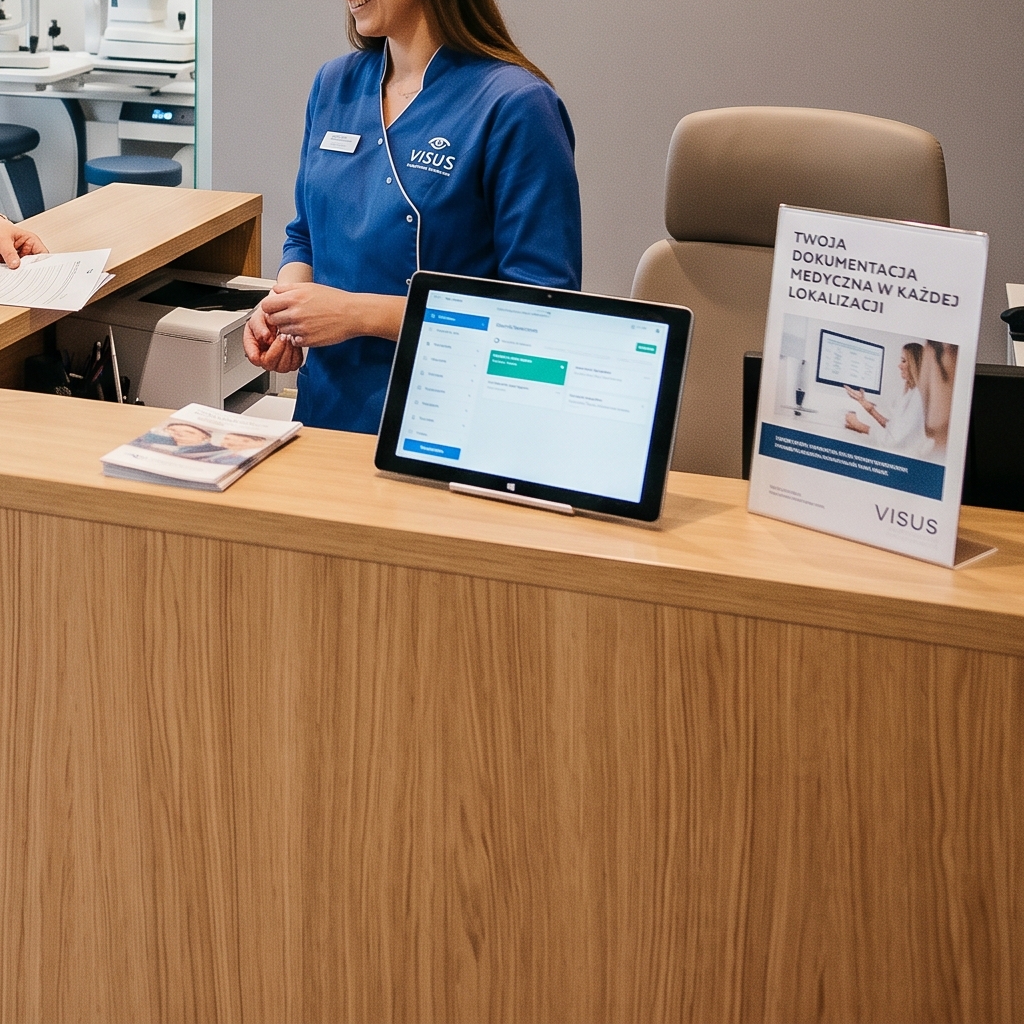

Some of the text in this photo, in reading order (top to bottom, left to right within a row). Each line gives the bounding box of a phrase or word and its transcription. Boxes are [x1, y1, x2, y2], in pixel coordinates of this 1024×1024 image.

[410, 149, 456, 170] VISUS
[794, 231, 847, 251] TWOJA
[792, 249, 918, 282] DOKUMENTACJA
[788, 286, 884, 314] LOKALIZACJI
[790, 268, 960, 308] MEDYCZNA W KAŻDEJ
[874, 503, 939, 535] VISUS
